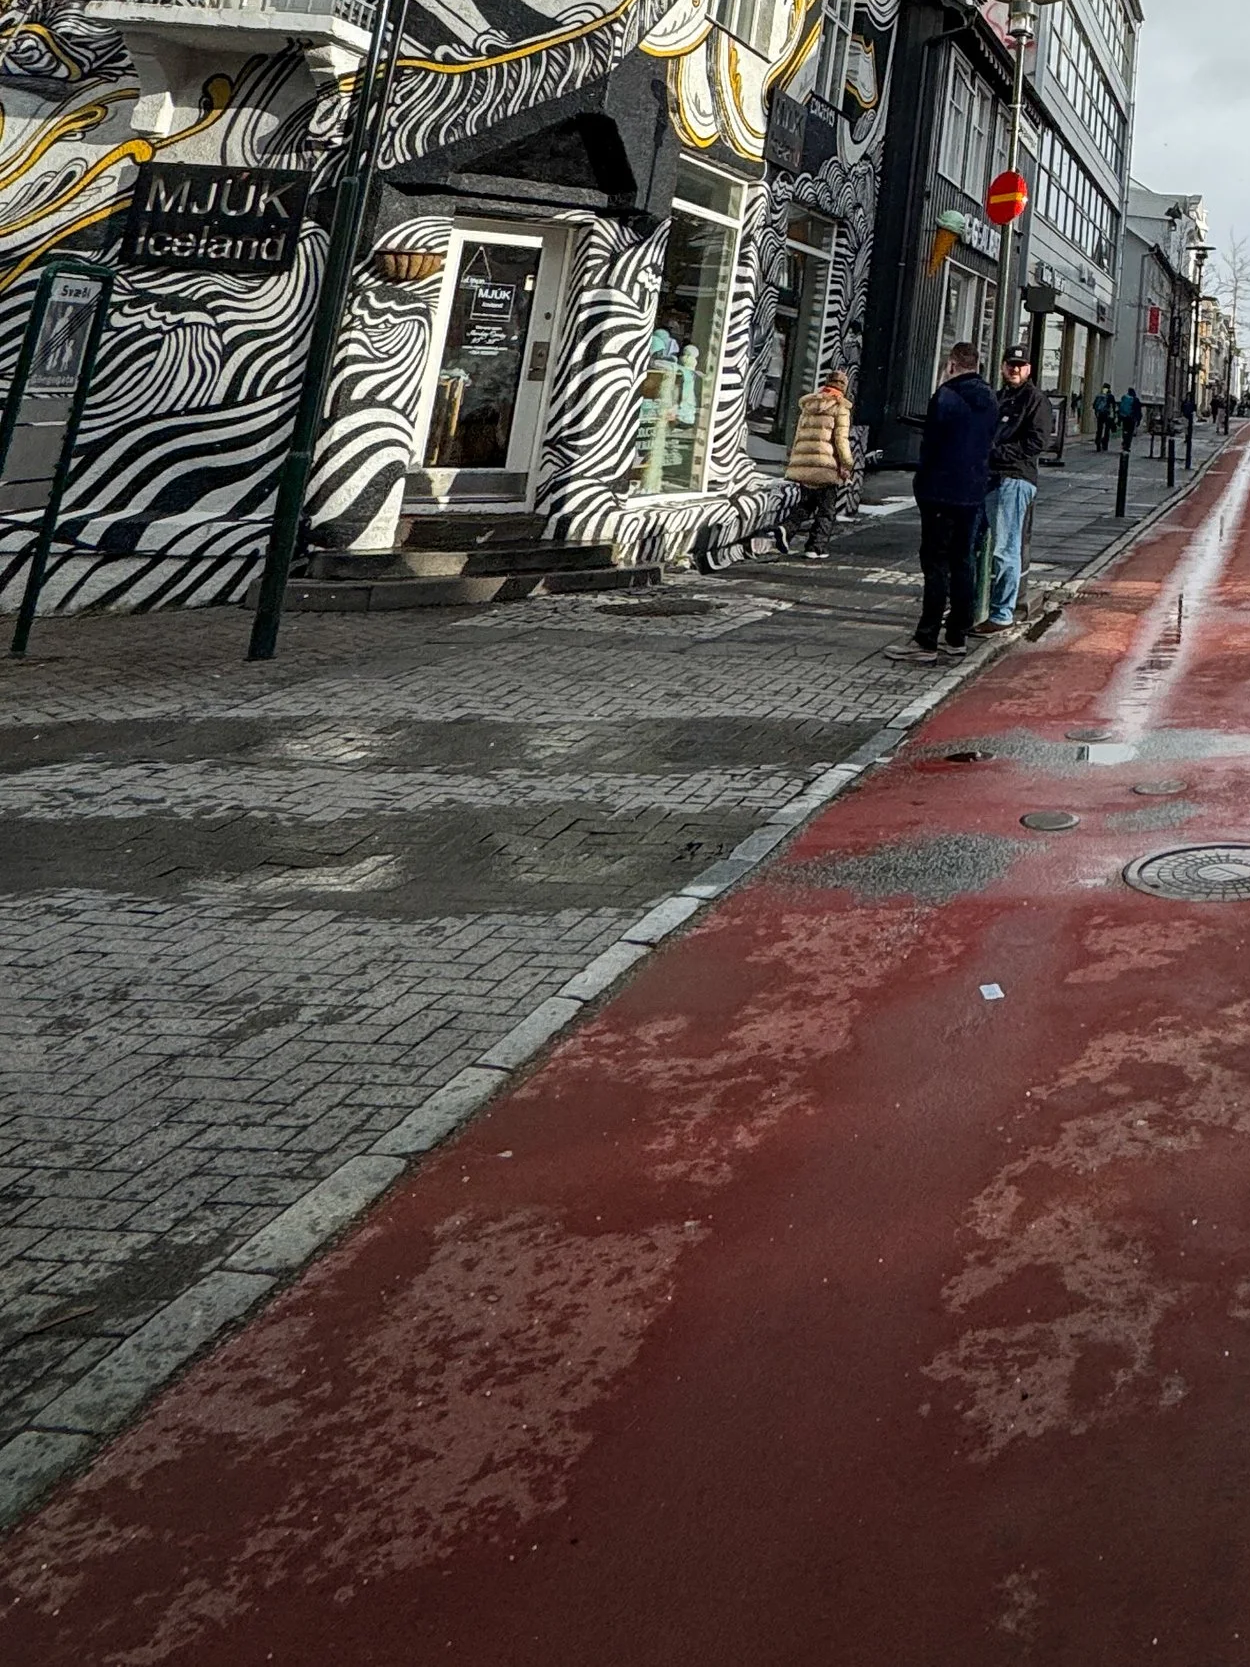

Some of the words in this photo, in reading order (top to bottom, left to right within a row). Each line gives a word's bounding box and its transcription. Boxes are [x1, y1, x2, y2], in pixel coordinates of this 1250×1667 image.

[145, 172, 295, 219] MJÚK
[135, 223, 286, 261] Iceland
[478, 287, 511, 301] MJÚK
